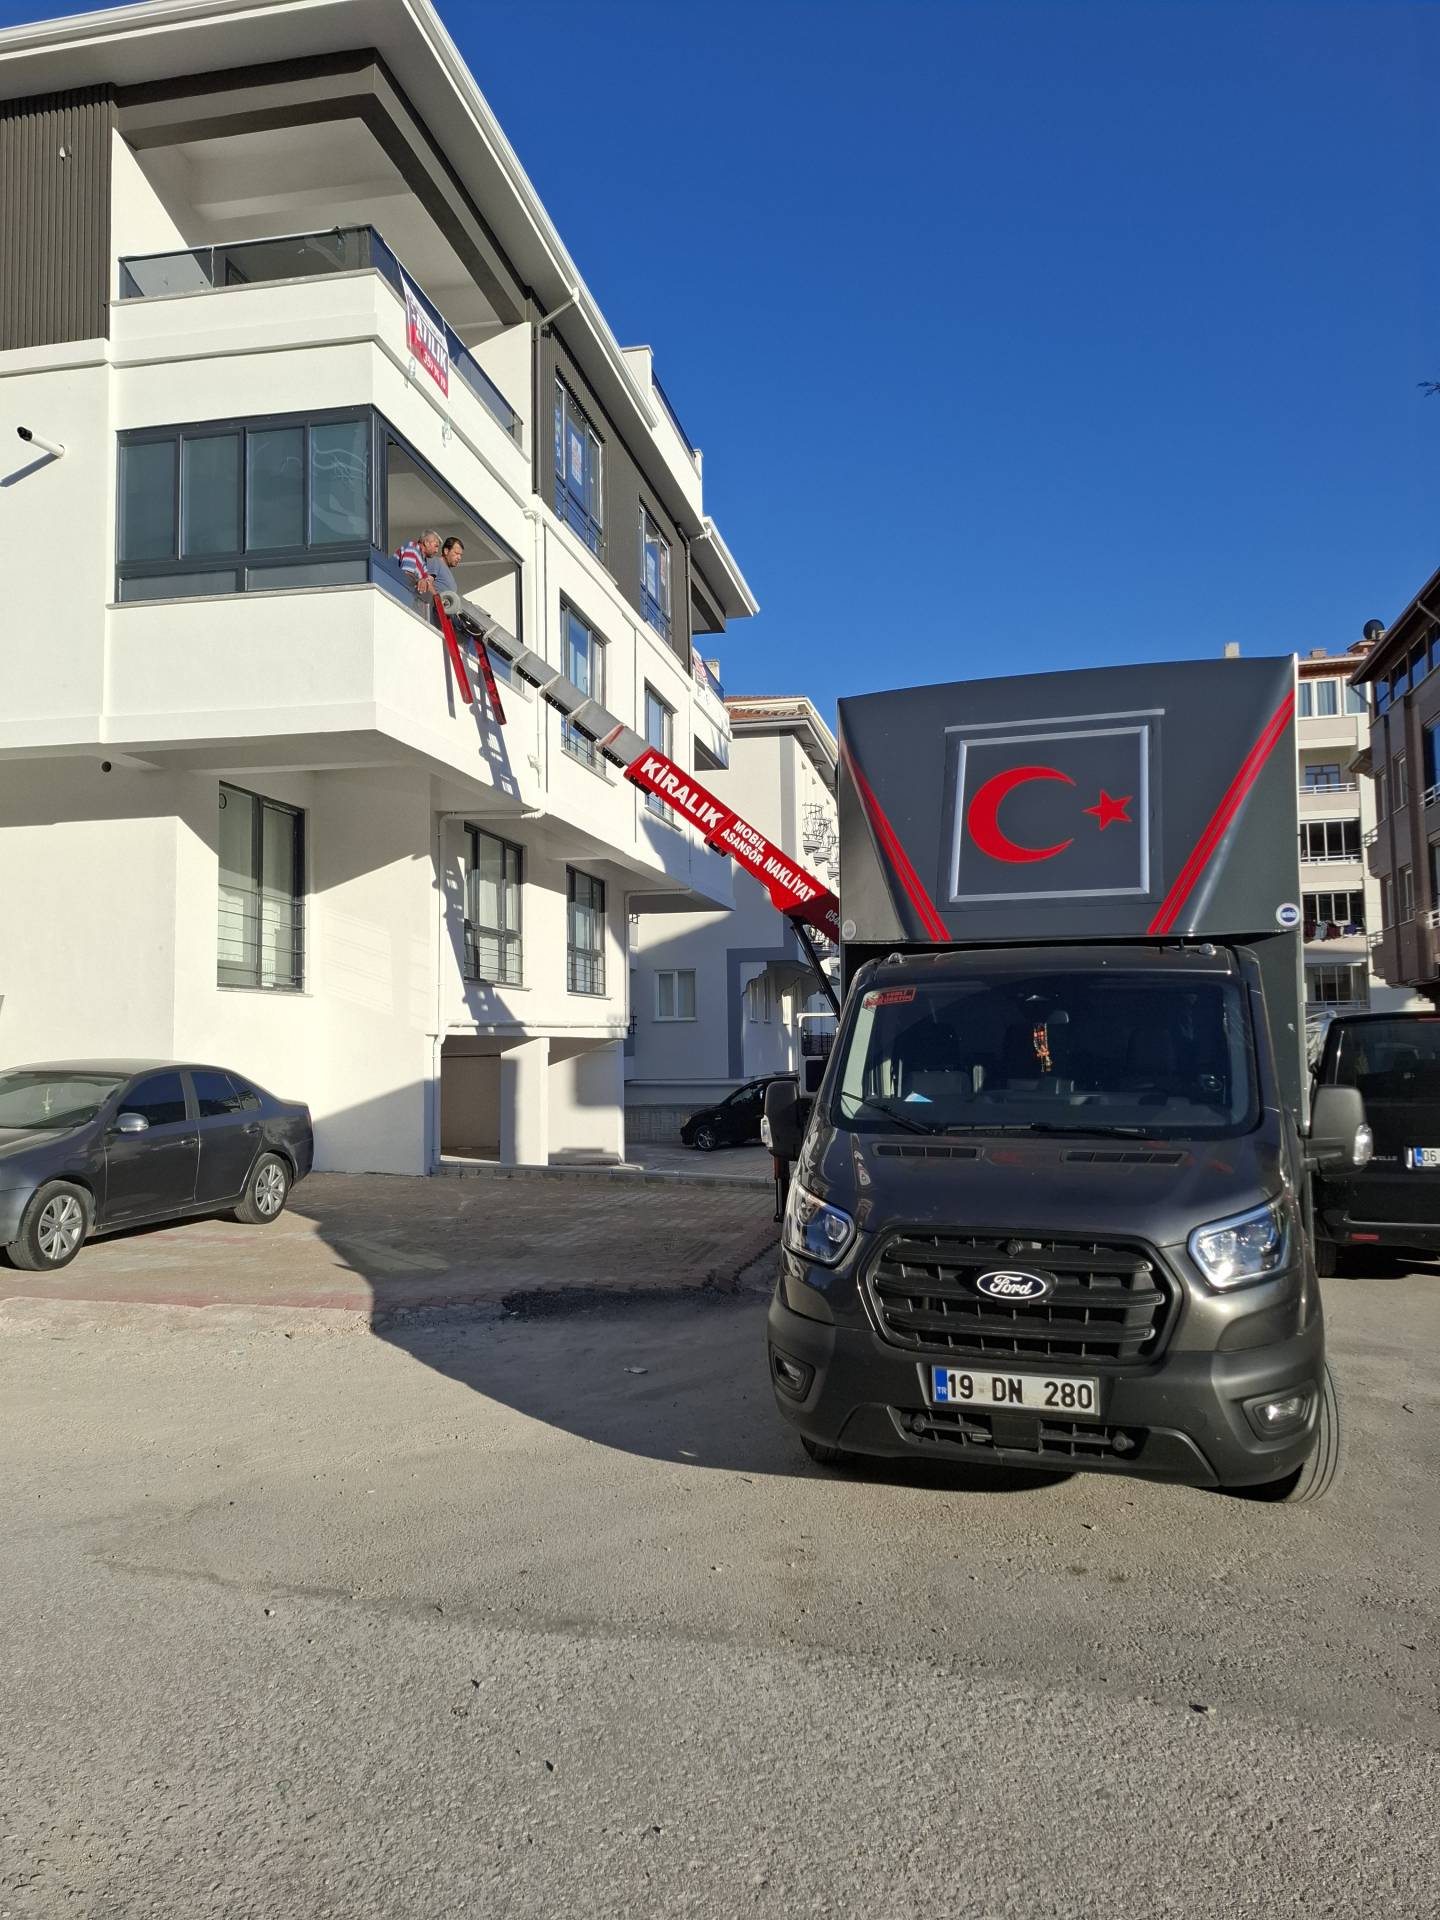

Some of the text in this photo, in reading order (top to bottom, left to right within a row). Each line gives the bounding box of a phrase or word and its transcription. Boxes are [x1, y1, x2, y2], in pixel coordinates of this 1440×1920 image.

[640, 756, 725, 829] KİRALIK
[720, 828, 764, 866] ASANSÖR
[732, 820, 767, 853] MOBİL
[762, 856, 817, 902] NAKLİYAT
[989, 1274, 1033, 1295] Ford
[937, 1373, 1093, 1409] TR 19 DN 280
